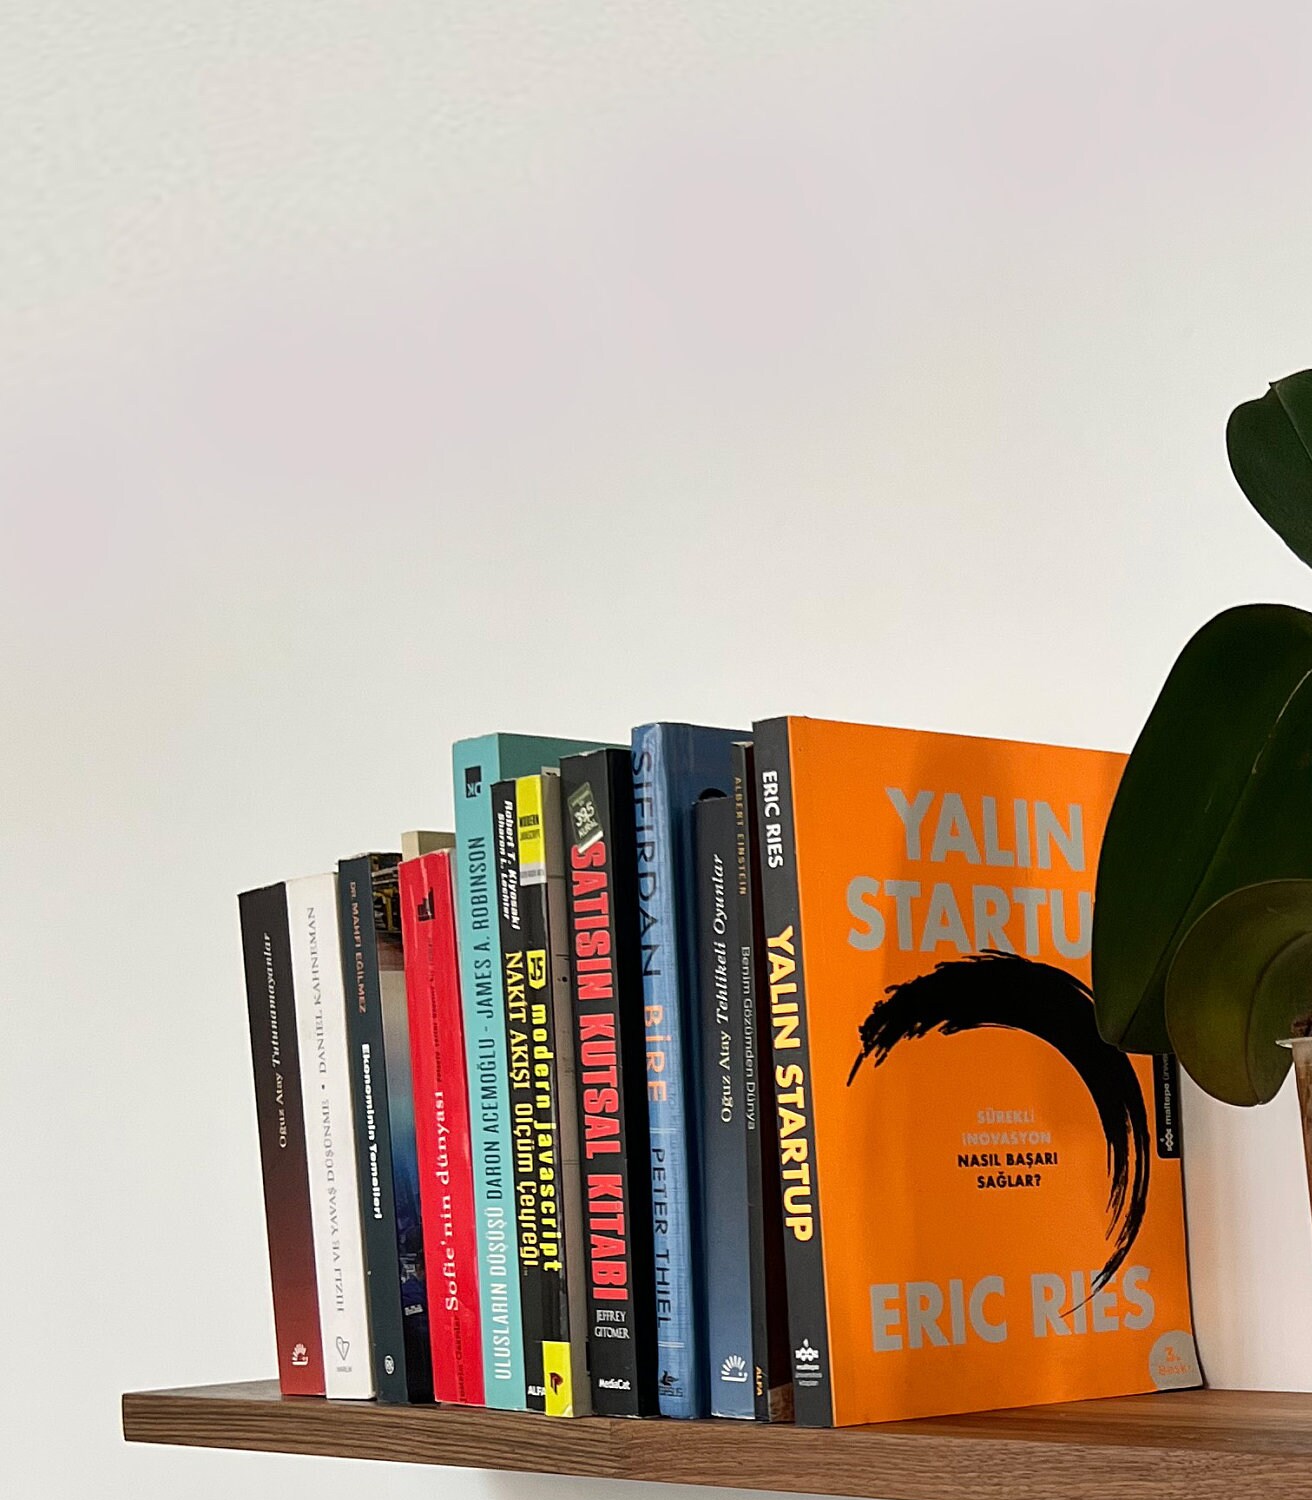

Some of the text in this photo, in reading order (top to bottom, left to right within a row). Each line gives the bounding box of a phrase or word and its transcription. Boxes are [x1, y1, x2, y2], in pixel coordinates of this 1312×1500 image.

[504, 800, 516, 850] Robert
[734, 776, 748, 896] ALBERT EINSTEIN
[762, 769, 785, 870] ERIC RIES
[885, 786, 1086, 872] YALIN
[633, 750, 661, 979] SIFIRDAN
[307, 906, 322, 1006] KAHNEMAN
[846, 875, 1092, 959] STARTU
[506, 951, 527, 1024] NAKİT
[712, 853, 733, 1124] Oğuz Atay Tehlikeli Oyunlar
[263, 932, 289, 1149] Oğuz Atay Tutunamayanlar
[315, 1008, 327, 1075] DANIEL
[509, 1029, 531, 1089] AKIŞI
[531, 1003, 554, 1109] modern
[741, 945, 756, 1131] Benim Gözümden Dünya
[468, 836, 513, 1380] ULUSLARIN DÜŞÜŞÜ DARON ACEMOĞLU JAMES A. ROBINSON
[579, 1012, 621, 1160] KUTSAL
[767, 924, 814, 1242] YALIN STARTUP
[321, 1098, 336, 1182] DÜŞÜNME
[435, 1091, 453, 1186] dünyası
[957, 1152, 1058, 1169] NASIL BAŞARI
[976, 1171, 1042, 1189] SAĞLAR?
[534, 1119, 564, 1273] javascript
[651, 1148, 673, 1330] PETER THIEL
[331, 1239, 341, 1262] VE
[334, 1269, 345, 1312] HIZLI
[440, 1195, 459, 1312] Sofie'nin
[594, 1326, 631, 1341] GITOMER
[595, 1309, 627, 1324] JEFFREY
[869, 1265, 1155, 1353] ERIC RIES
[599, 1378, 631, 1391] MediaCat
[755, 1366, 764, 1397] ALFA
